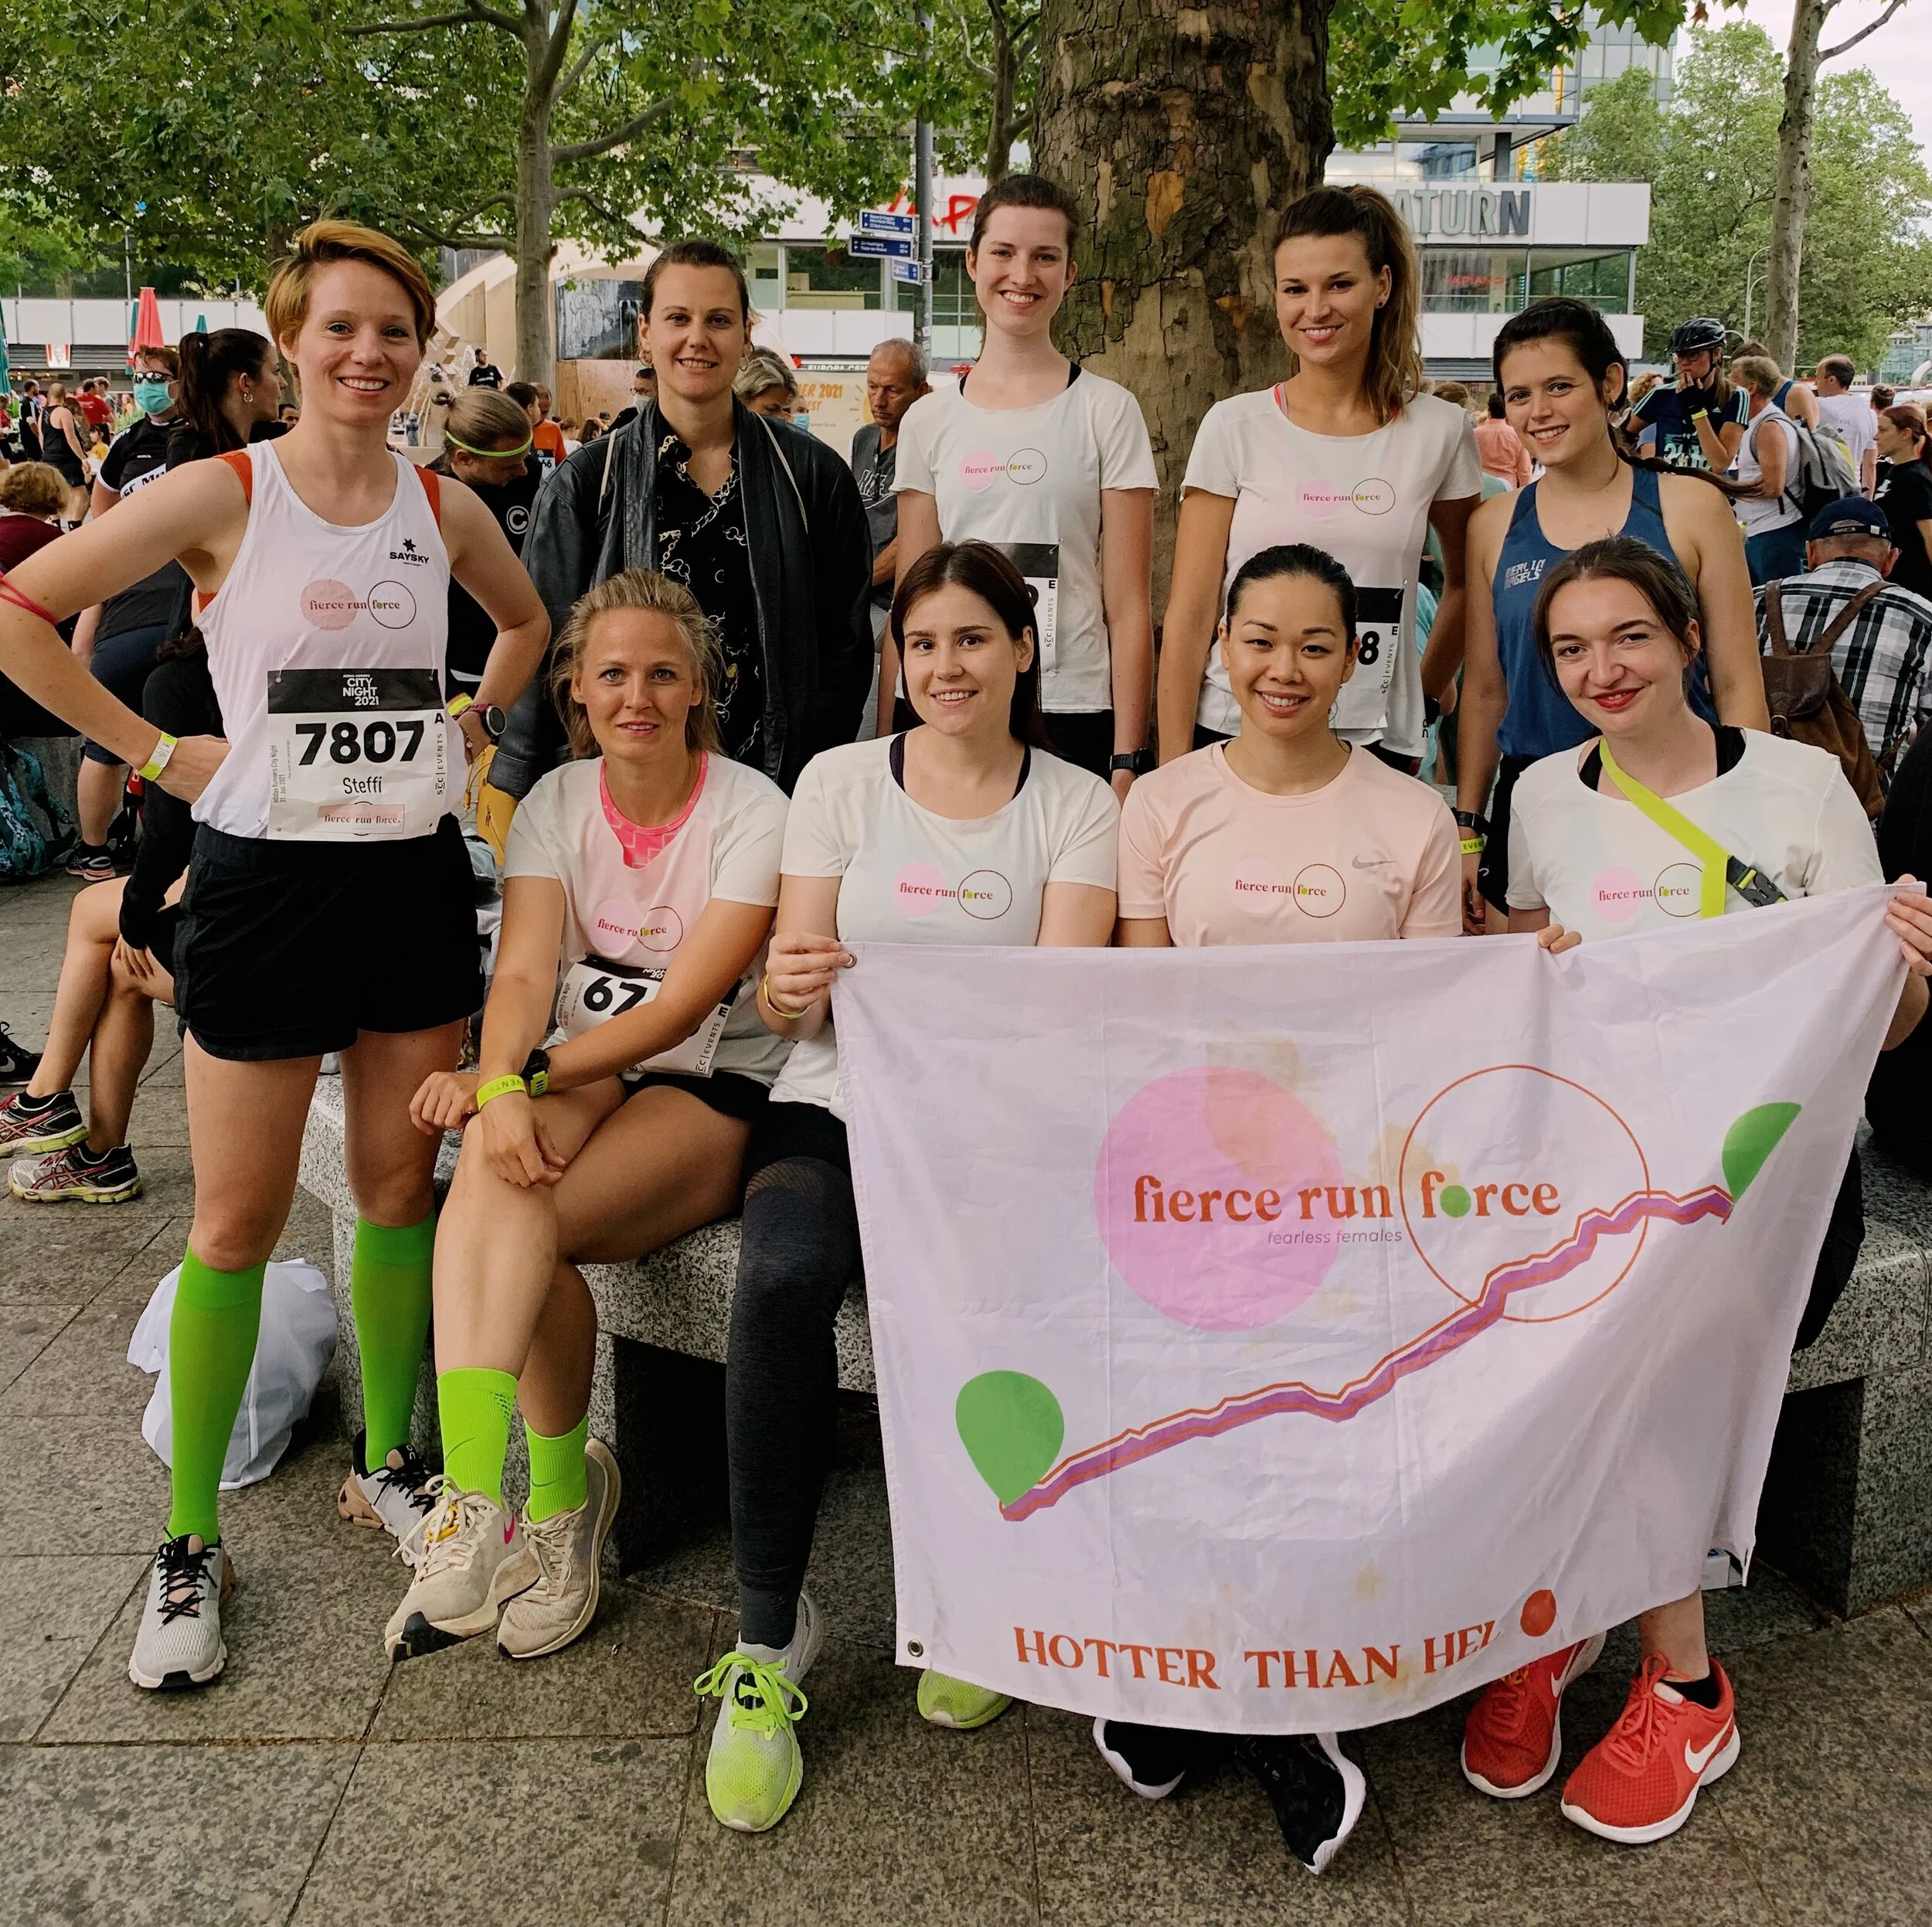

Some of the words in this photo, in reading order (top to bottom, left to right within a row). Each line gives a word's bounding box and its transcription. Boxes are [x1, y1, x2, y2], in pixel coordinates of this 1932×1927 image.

[1393, 189, 1531, 237] ATURN
[818, 383, 843, 399] 2021
[1303, 493, 1331, 502] fierce
[389, 551, 430, 564] SAYSKY
[1049, 580, 1056, 589] E
[310, 600, 344, 610] fierce
[1391, 626, 1398, 635] E
[1385, 643, 1394, 674] EVENTS
[347, 678, 373, 688] CITY
[342, 686, 378, 697] NIGHT
[354, 696, 379, 706] 2021
[434, 713, 444, 724] A
[295, 720, 424, 766] 7807
[342, 776, 383, 794] Steffi
[325, 814, 351, 822] fierce
[900, 882, 932, 895] fierce
[935, 889, 956, 897] run
[1235, 879, 1268, 892] fierce
[1271, 883, 1291, 894] run
[1599, 890, 1629, 901] fierce
[1633, 889, 1653, 898] run
[597, 918, 624, 935] fierce
[628, 928, 638, 937] ru
[718, 1006, 729, 1018] E
[704, 1022, 720, 1054] EVENTS
[489, 1078, 525, 1093] VENTS
[1133, 1174, 1281, 1223] fierce
[1296, 1179, 1393, 1221] run
[1420, 1170, 1561, 1219] force
[1267, 1228, 1331, 1245] fearless
[1336, 1227, 1403, 1244] females
[1012, 1626, 1221, 1690] HOTTER
[1243, 1645, 1400, 1689] THAN
[1423, 1619, 1501, 1675] HEL
